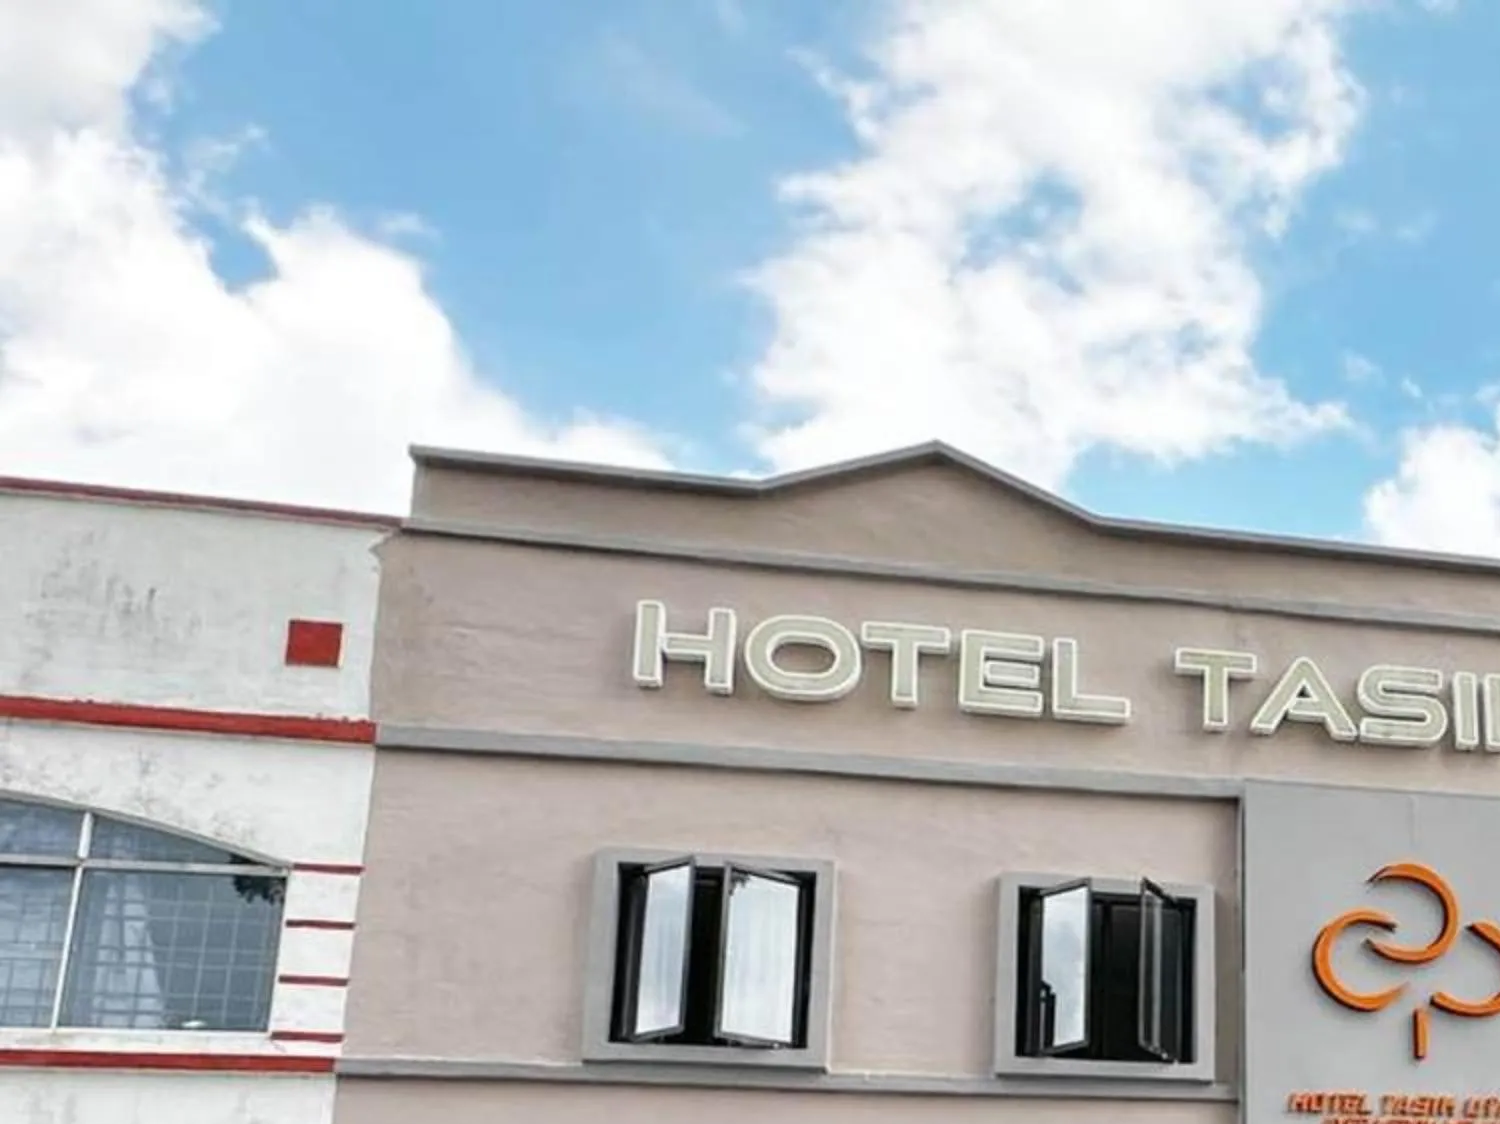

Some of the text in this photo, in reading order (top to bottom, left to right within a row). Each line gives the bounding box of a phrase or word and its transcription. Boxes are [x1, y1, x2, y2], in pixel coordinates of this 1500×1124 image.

[633, 600, 1131, 724] HOTEL
[1287, 1092, 1371, 1114] HOTEL
[1380, 1094, 1455, 1116] TASIK
